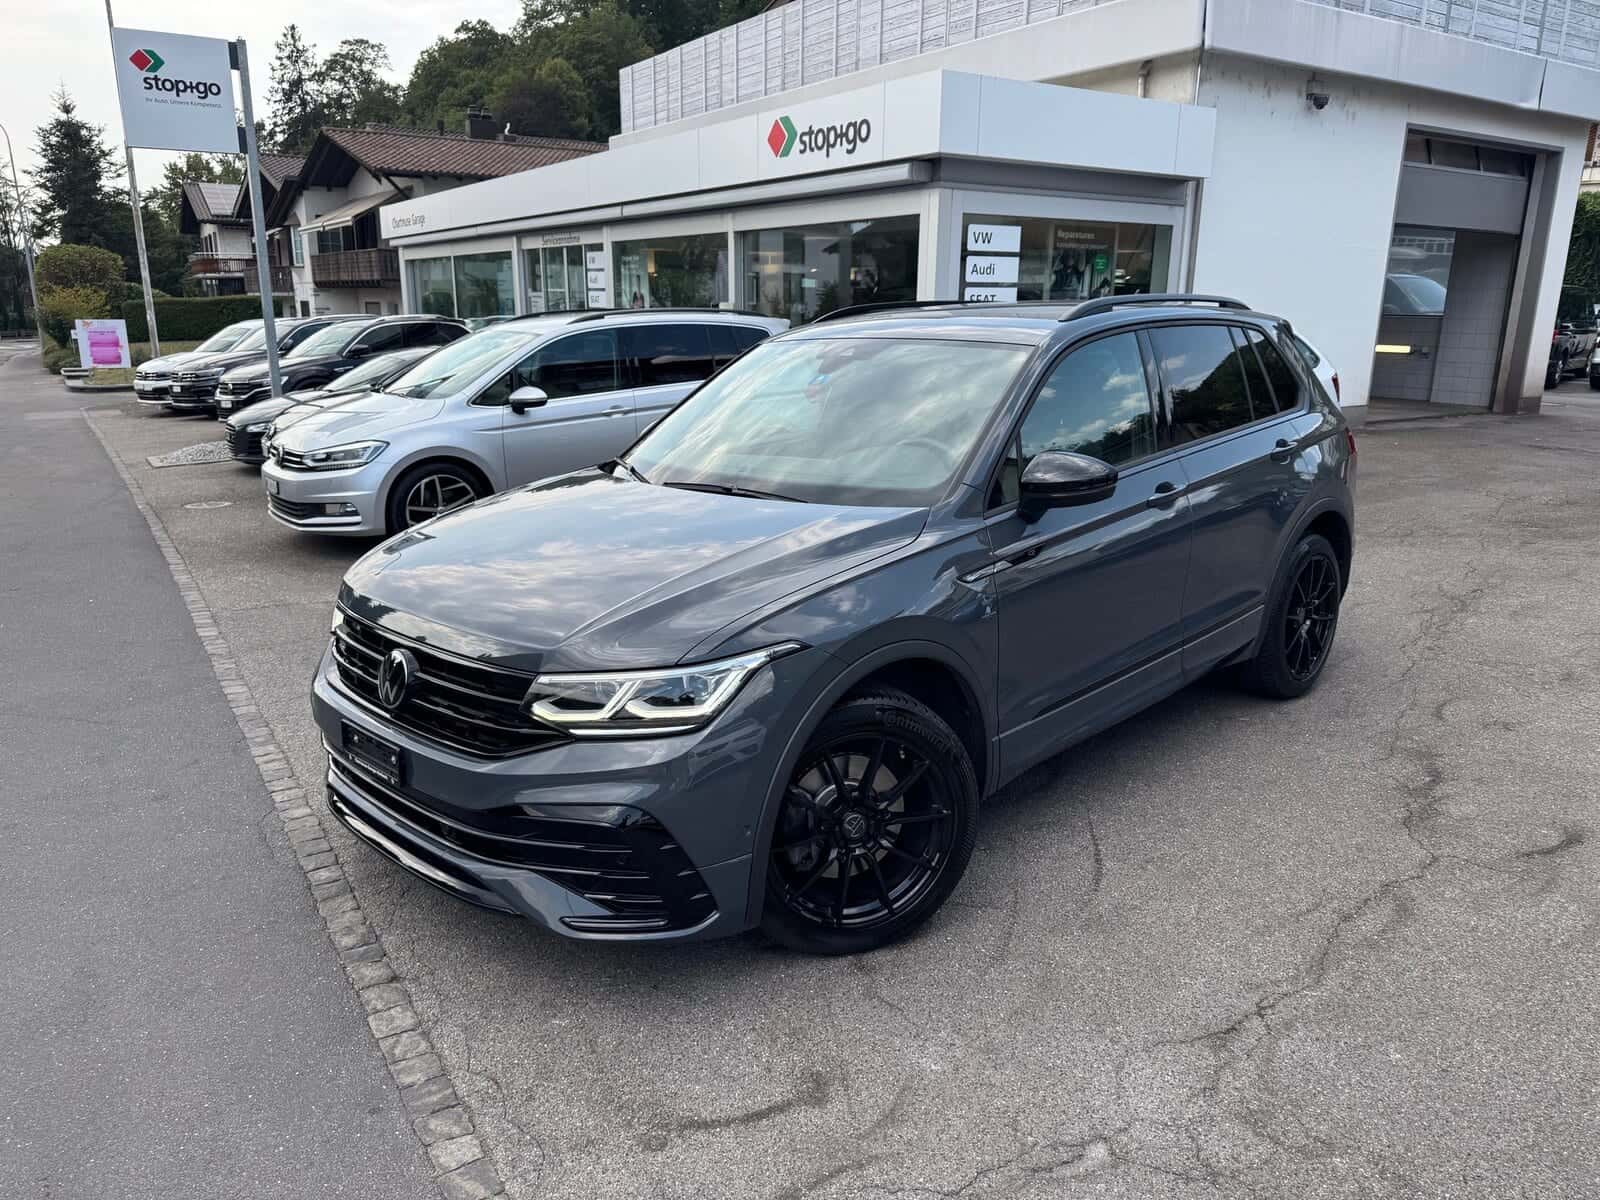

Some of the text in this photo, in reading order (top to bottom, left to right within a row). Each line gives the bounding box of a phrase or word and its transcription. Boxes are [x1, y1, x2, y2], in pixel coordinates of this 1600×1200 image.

[143, 75, 221, 99] stop+go
[799, 118, 871, 158] stop+go
[973, 231, 993, 244] VW
[971, 263, 996, 275] Audi
